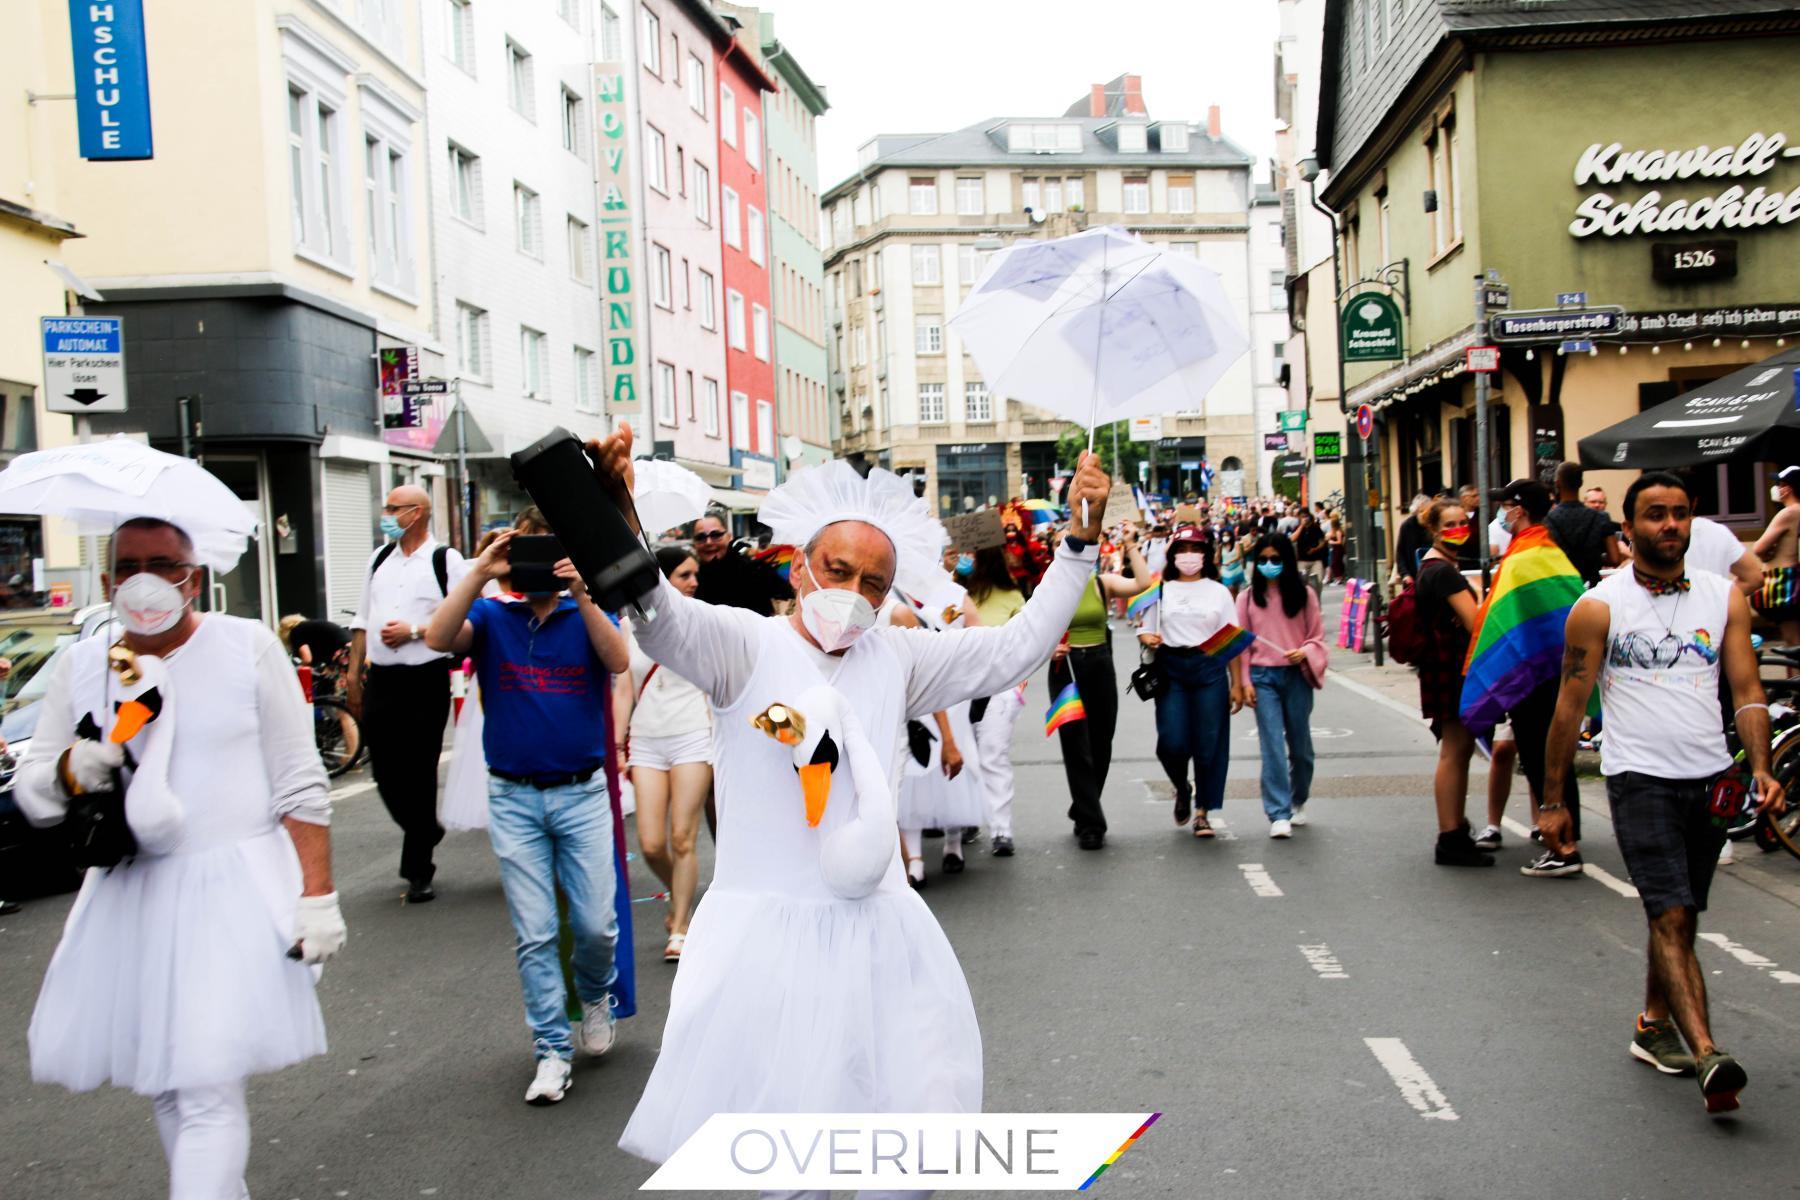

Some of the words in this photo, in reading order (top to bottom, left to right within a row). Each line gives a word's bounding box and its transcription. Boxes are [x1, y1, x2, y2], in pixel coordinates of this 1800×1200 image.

[90, 0, 121, 149] HSCHULE
[597, 74, 628, 211] NOVA
[1674, 250, 1716, 269] 1526
[1563, 294, 1581, 304] 2-6
[605, 231, 636, 402] RONDA
[44, 320, 119, 334] PARKSCHEIN-
[1505, 314, 1610, 333] Rosenbergerstraße
[57, 338, 108, 351] AUTOMAT
[48, 358, 65, 368] Hier
[70, 357, 119, 368] Parkschein
[72, 372, 97, 383] lösen
[1315, 435, 1340, 445] SOJU
[1316, 446, 1339, 455] BAR
